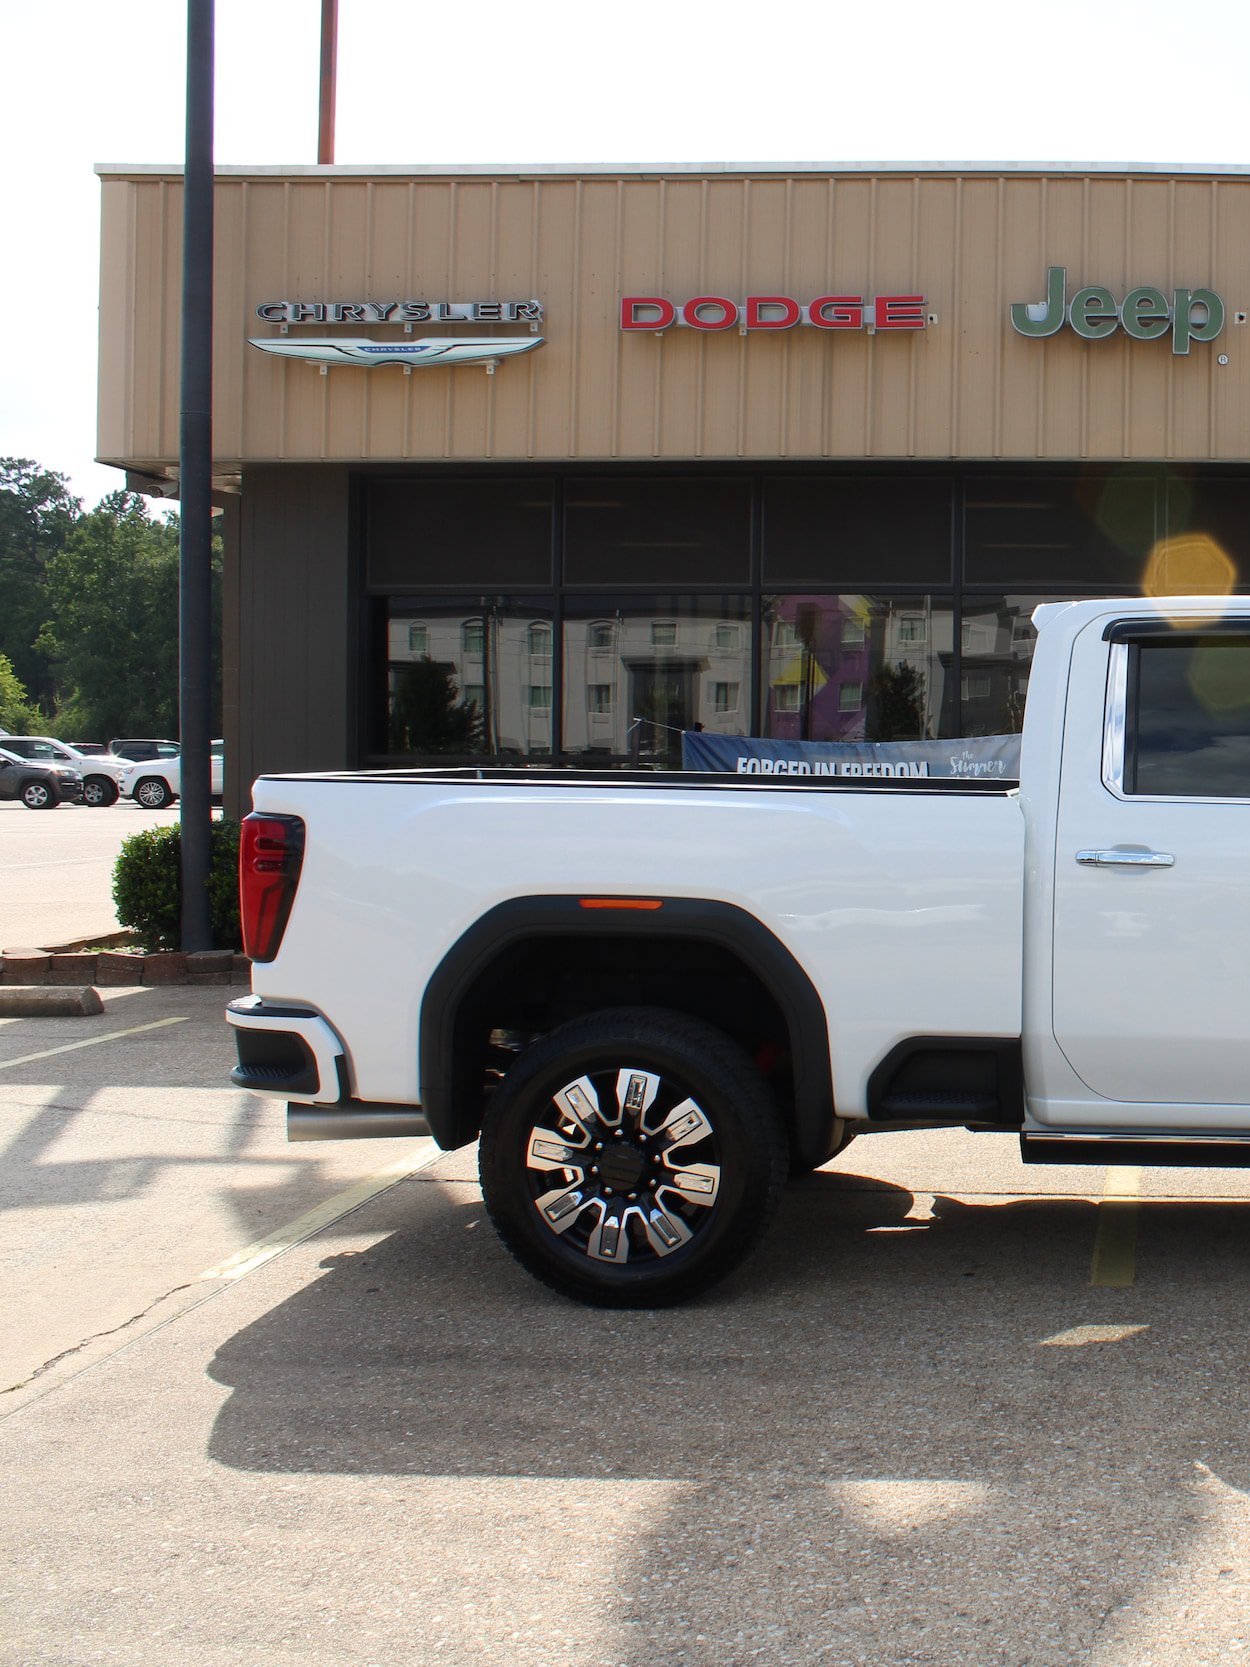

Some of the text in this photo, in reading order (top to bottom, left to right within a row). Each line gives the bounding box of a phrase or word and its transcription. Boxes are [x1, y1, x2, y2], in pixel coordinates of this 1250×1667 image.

[255, 301, 541, 322] CHRYSLER
[620, 296, 926, 331] DODGE
[1010, 267, 1225, 355] Jeep
